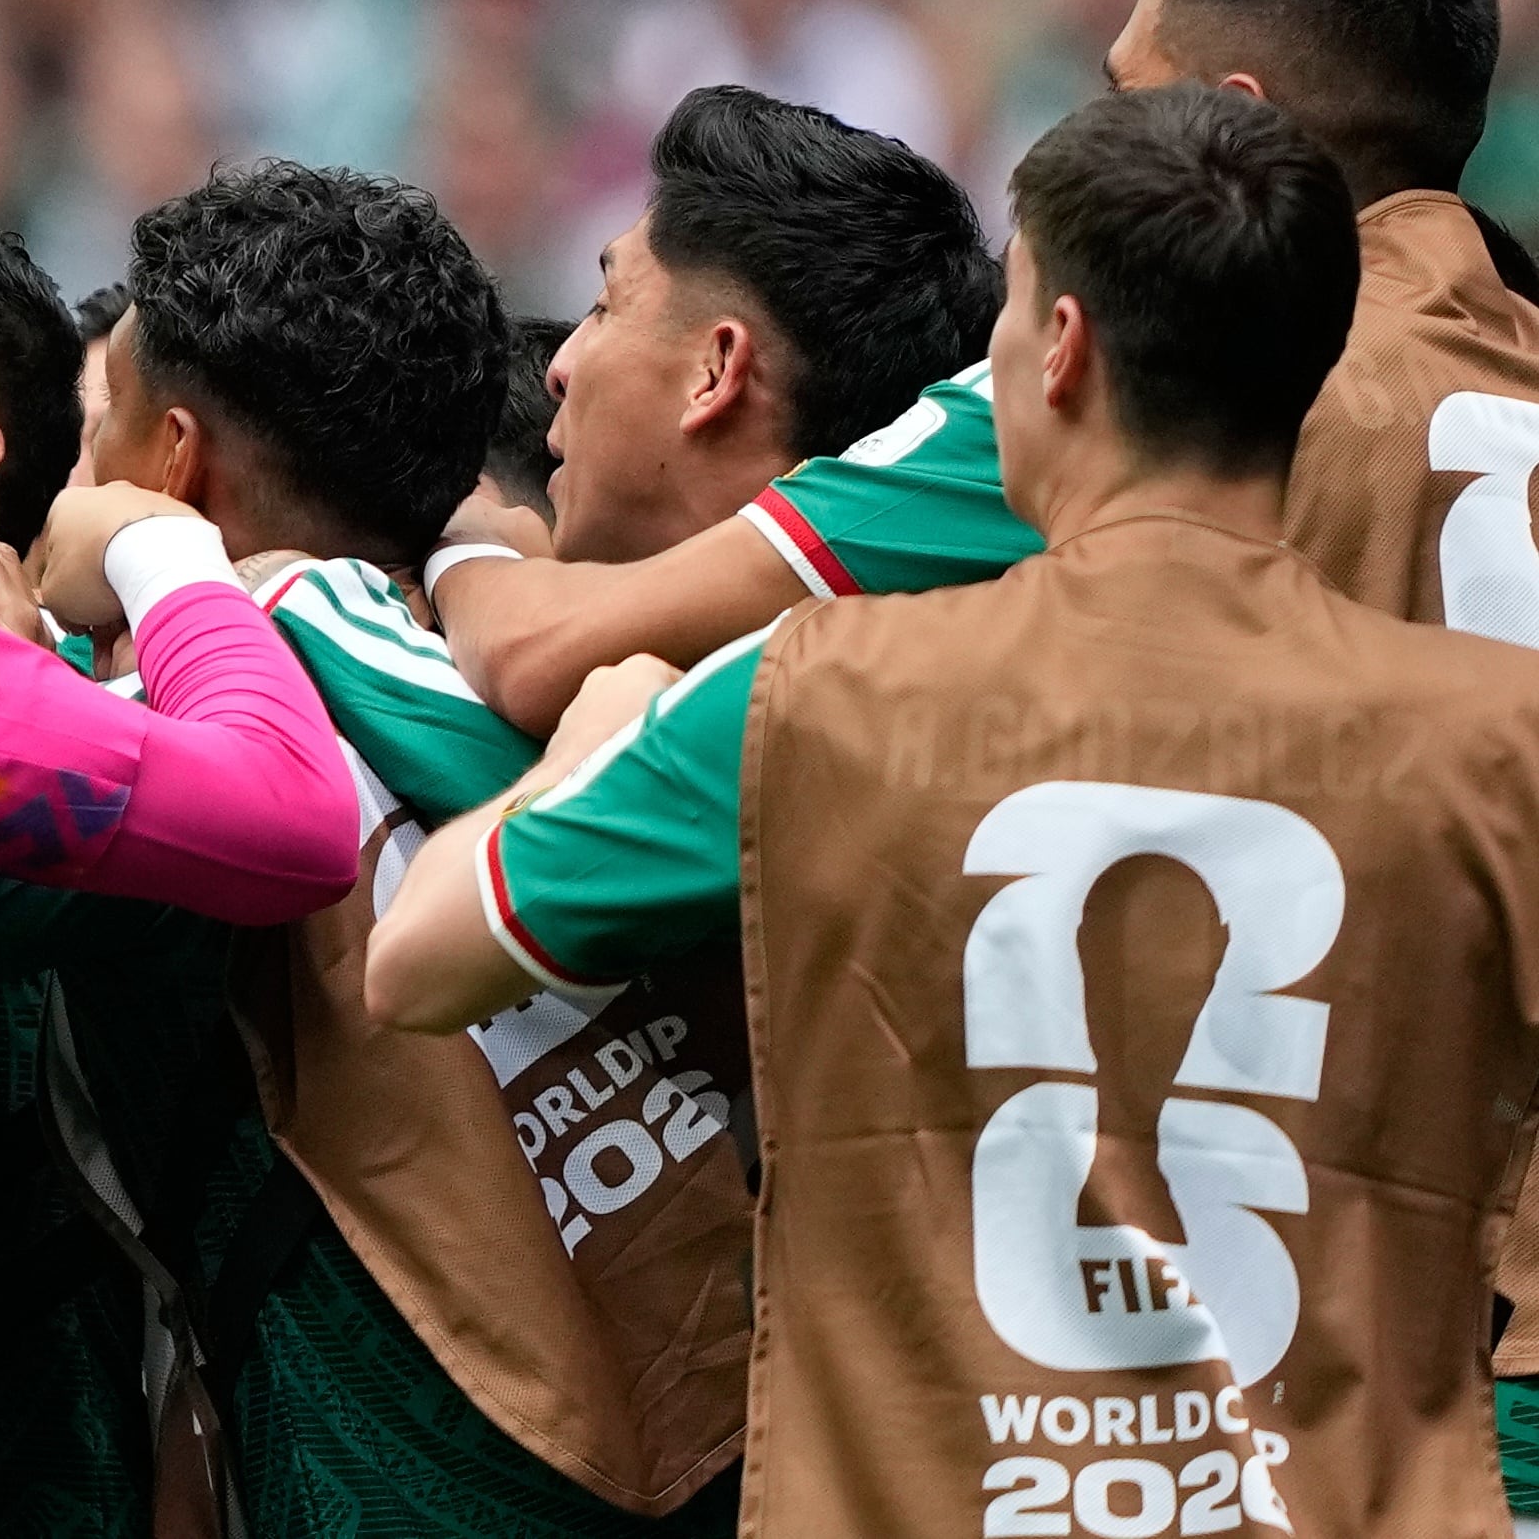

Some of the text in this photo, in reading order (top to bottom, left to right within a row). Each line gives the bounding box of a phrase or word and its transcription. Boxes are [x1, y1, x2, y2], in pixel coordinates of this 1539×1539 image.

[514, 1037, 645, 1174] ORLD
[1079, 1257, 1201, 1314] FIF
[979, 1390, 1211, 1447] WORLD
